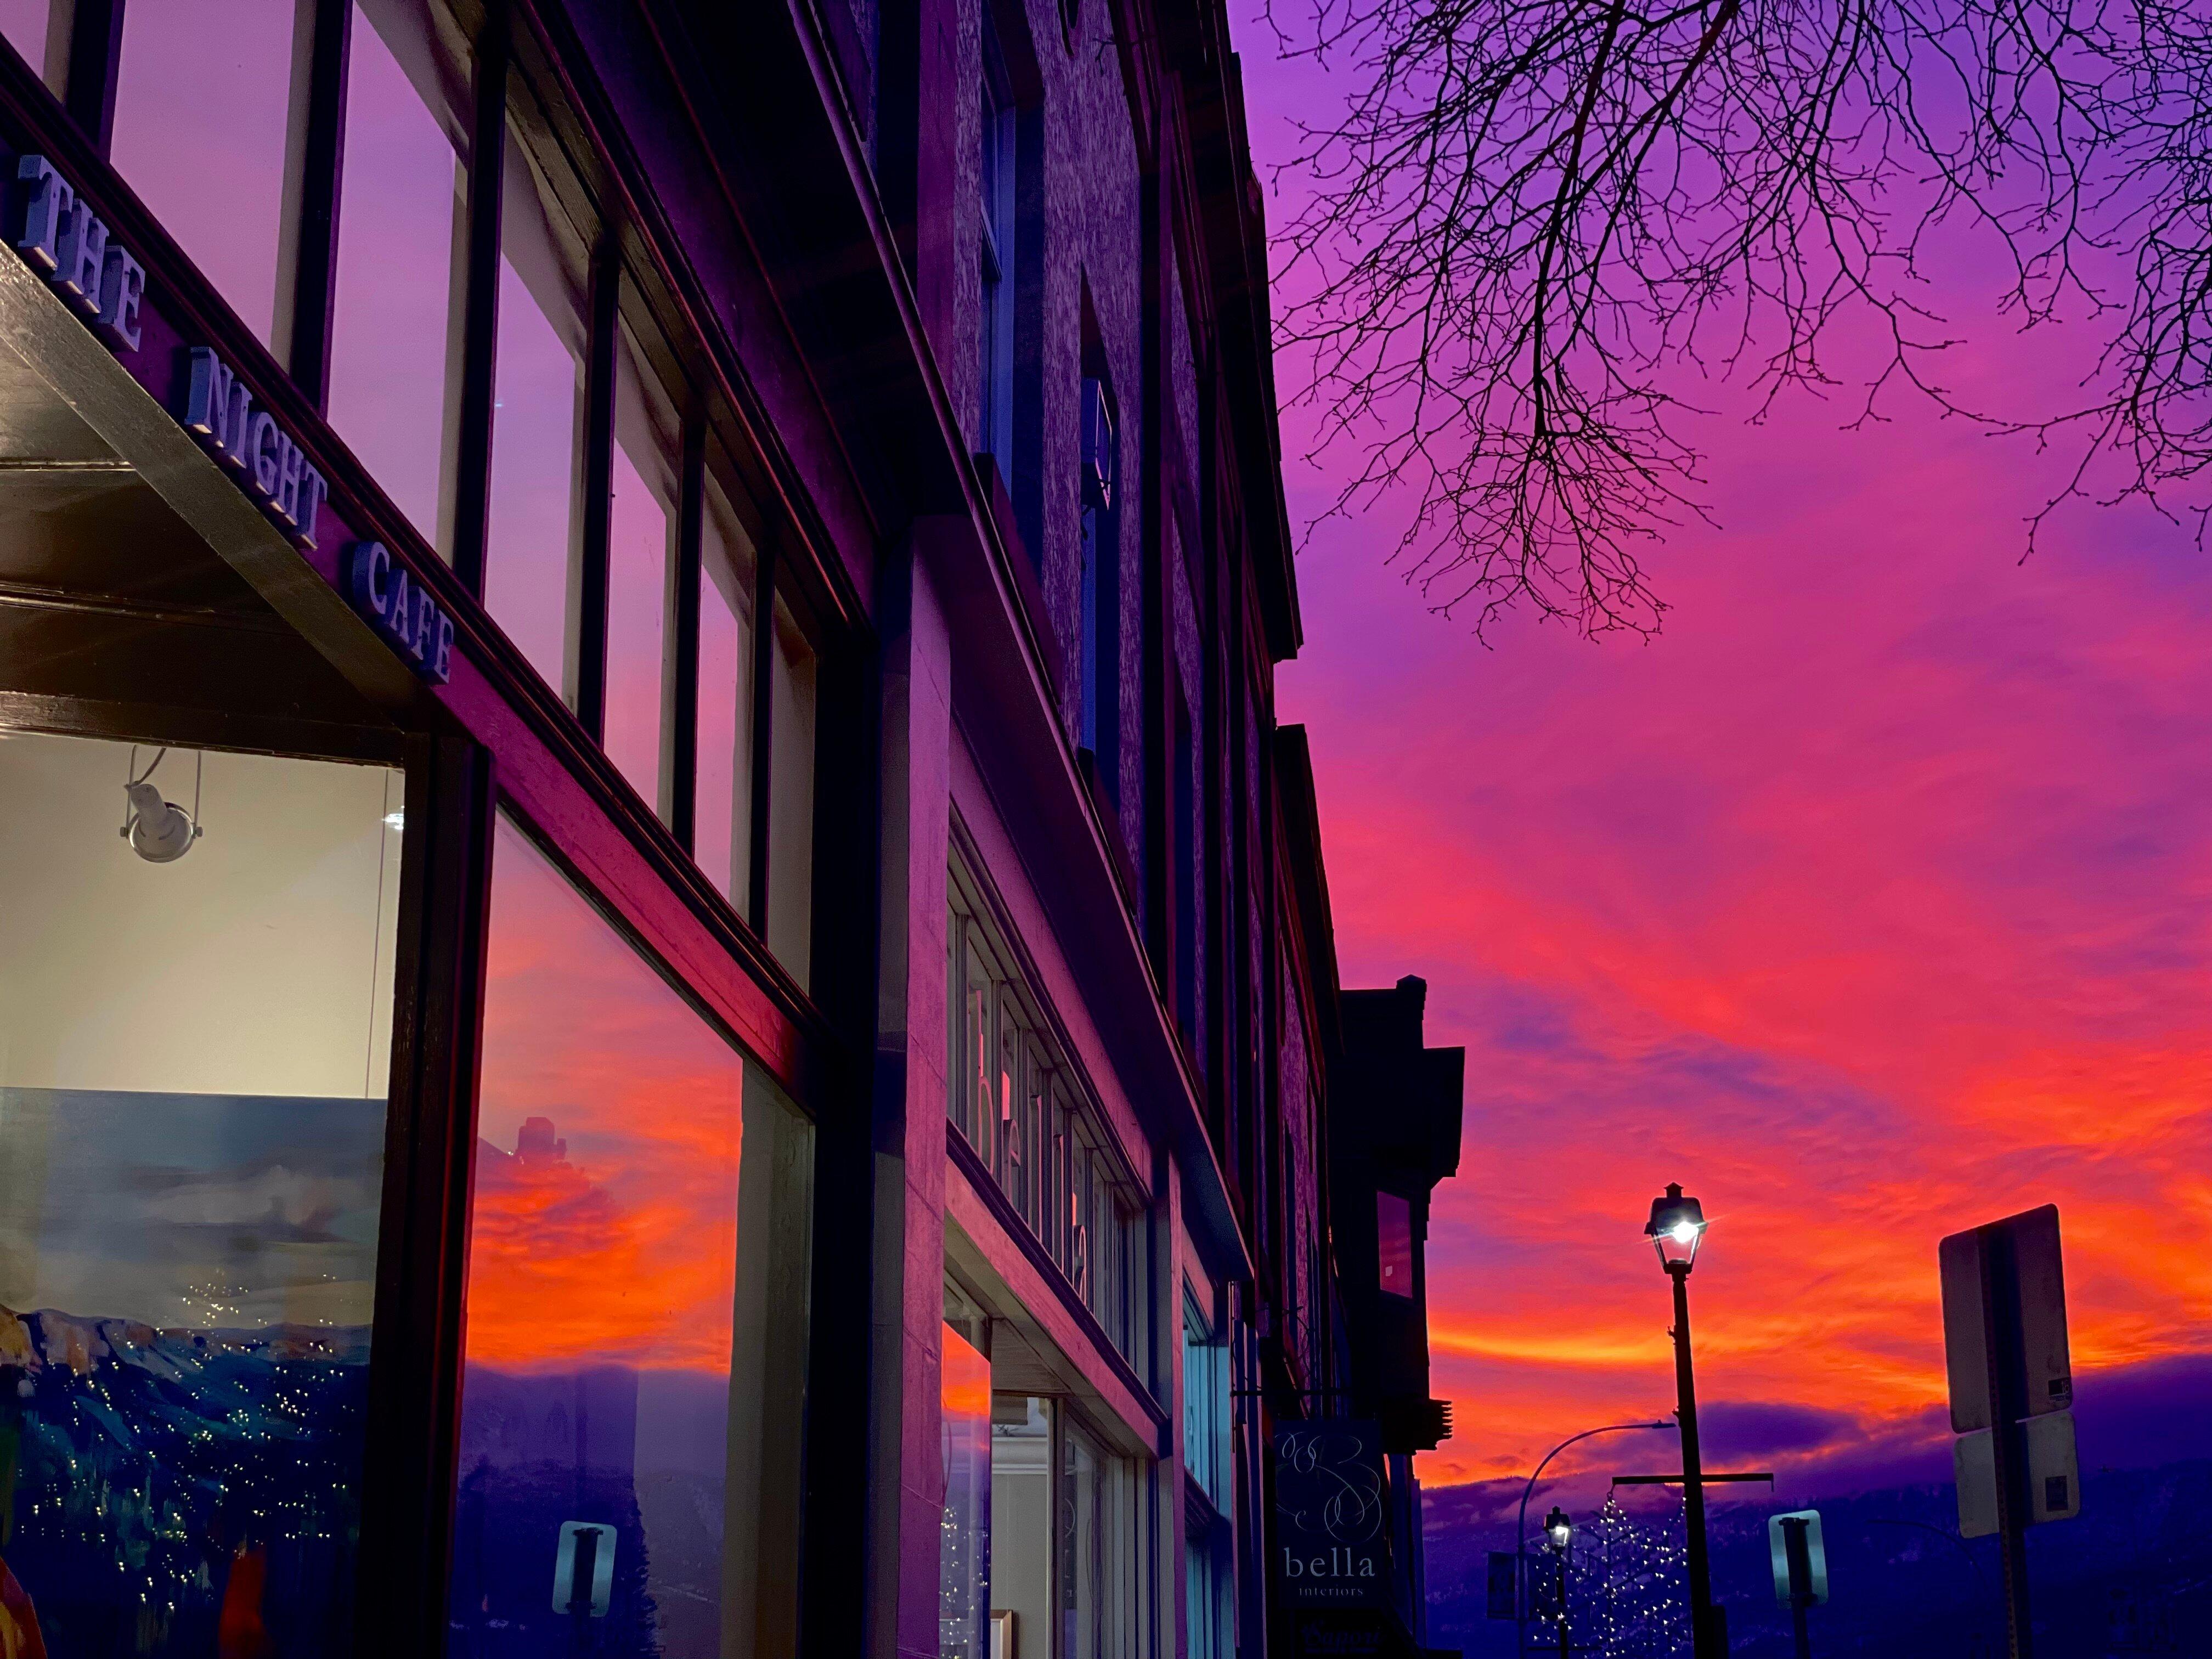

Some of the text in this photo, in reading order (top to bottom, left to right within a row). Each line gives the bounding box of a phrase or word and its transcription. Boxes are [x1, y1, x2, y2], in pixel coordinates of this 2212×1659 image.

[18, 155, 454, 684] THE NIGHT CAFE
[1283, 1547, 1375, 1577] bella
[1299, 1584, 1364, 1596] interiors
